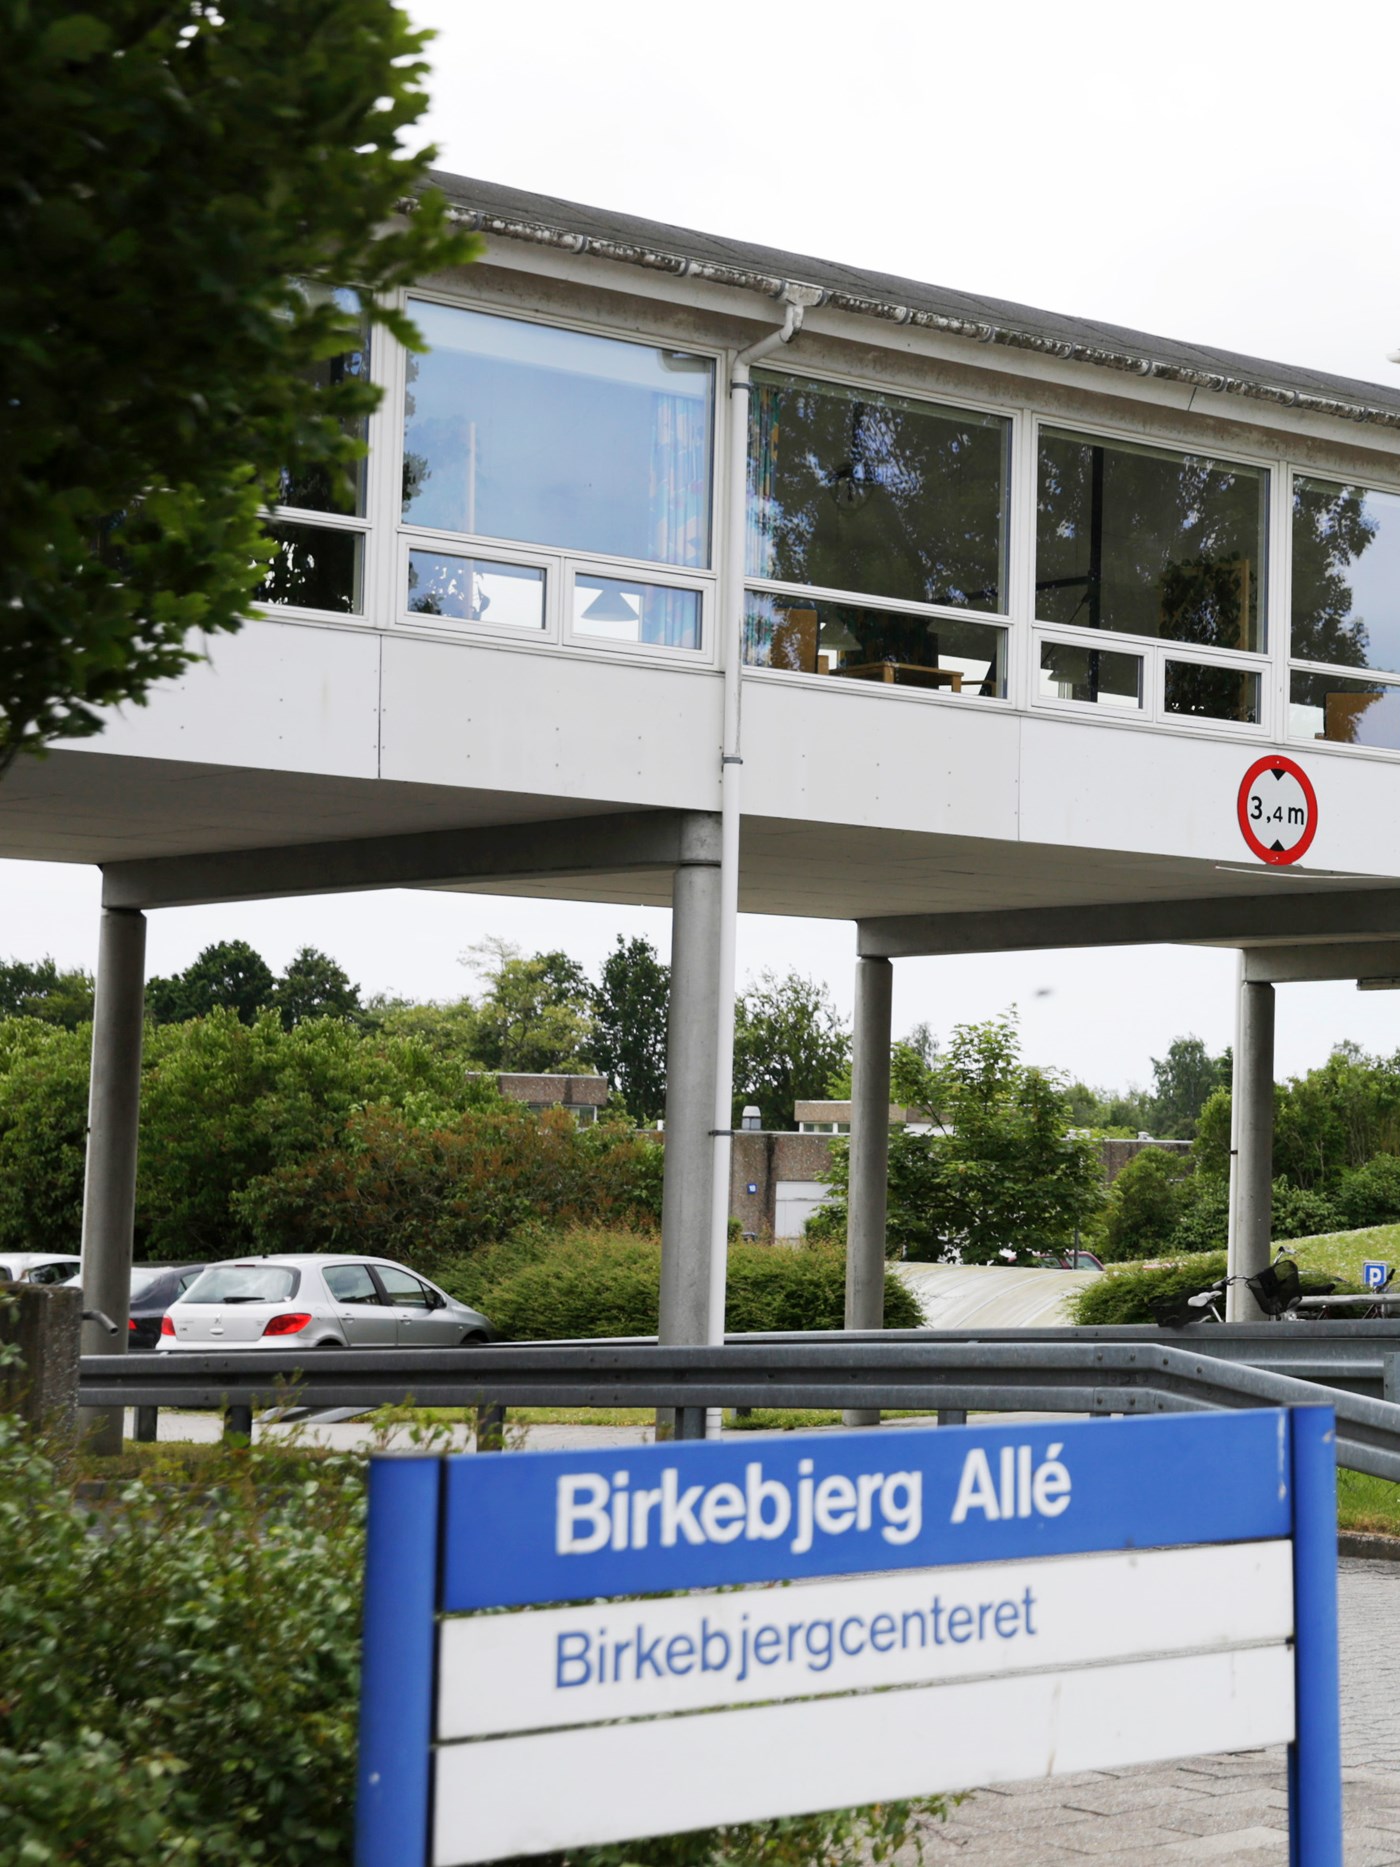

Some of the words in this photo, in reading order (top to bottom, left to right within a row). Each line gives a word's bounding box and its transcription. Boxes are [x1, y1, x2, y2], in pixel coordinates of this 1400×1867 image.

[1369, 1267, 1382, 1288] P
[556, 1458, 923, 1555] Birkebjerg
[949, 1442, 1072, 1525] Allé
[554, 1586, 1038, 1690] Birkebjergcenteret
